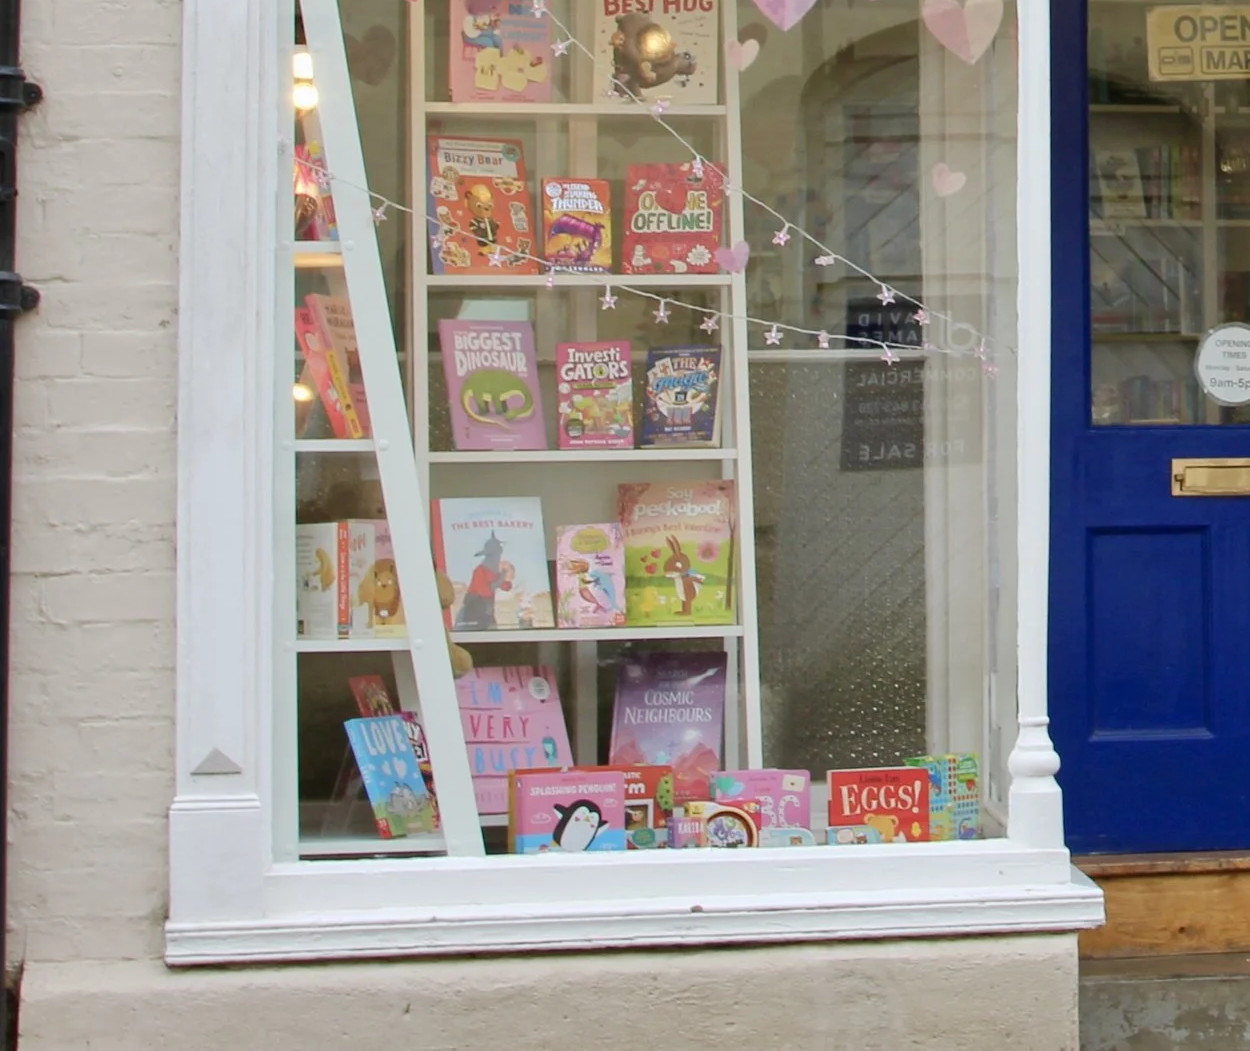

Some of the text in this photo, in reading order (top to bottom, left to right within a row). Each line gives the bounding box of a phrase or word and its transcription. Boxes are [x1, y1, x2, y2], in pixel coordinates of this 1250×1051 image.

[443, 152, 504, 166] Bizzy Bear
[633, 211, 712, 231] OFFLINE!
[454, 332, 522, 350] BIGGEST
[454, 350, 529, 378] DINOSAUR
[567, 347, 621, 363] Investi
[671, 357, 698, 370] THE
[1222, 351, 1248, 360] TIMES
[560, 360, 629, 381] GATORS
[668, 487, 694, 501] Say
[634, 499, 722, 520] peekaboo!
[451, 519, 535, 531] THE BEST BAKERY
[644, 689, 694, 706] COSMIC
[624, 707, 713, 725] NEIGHBOURS
[469, 714, 530, 739] VERY
[359, 719, 407, 757] LOVE
[475, 746, 537, 775] BUSY
[530, 785, 577, 797] SPLASHING
[839, 779, 923, 817] EGGS!
